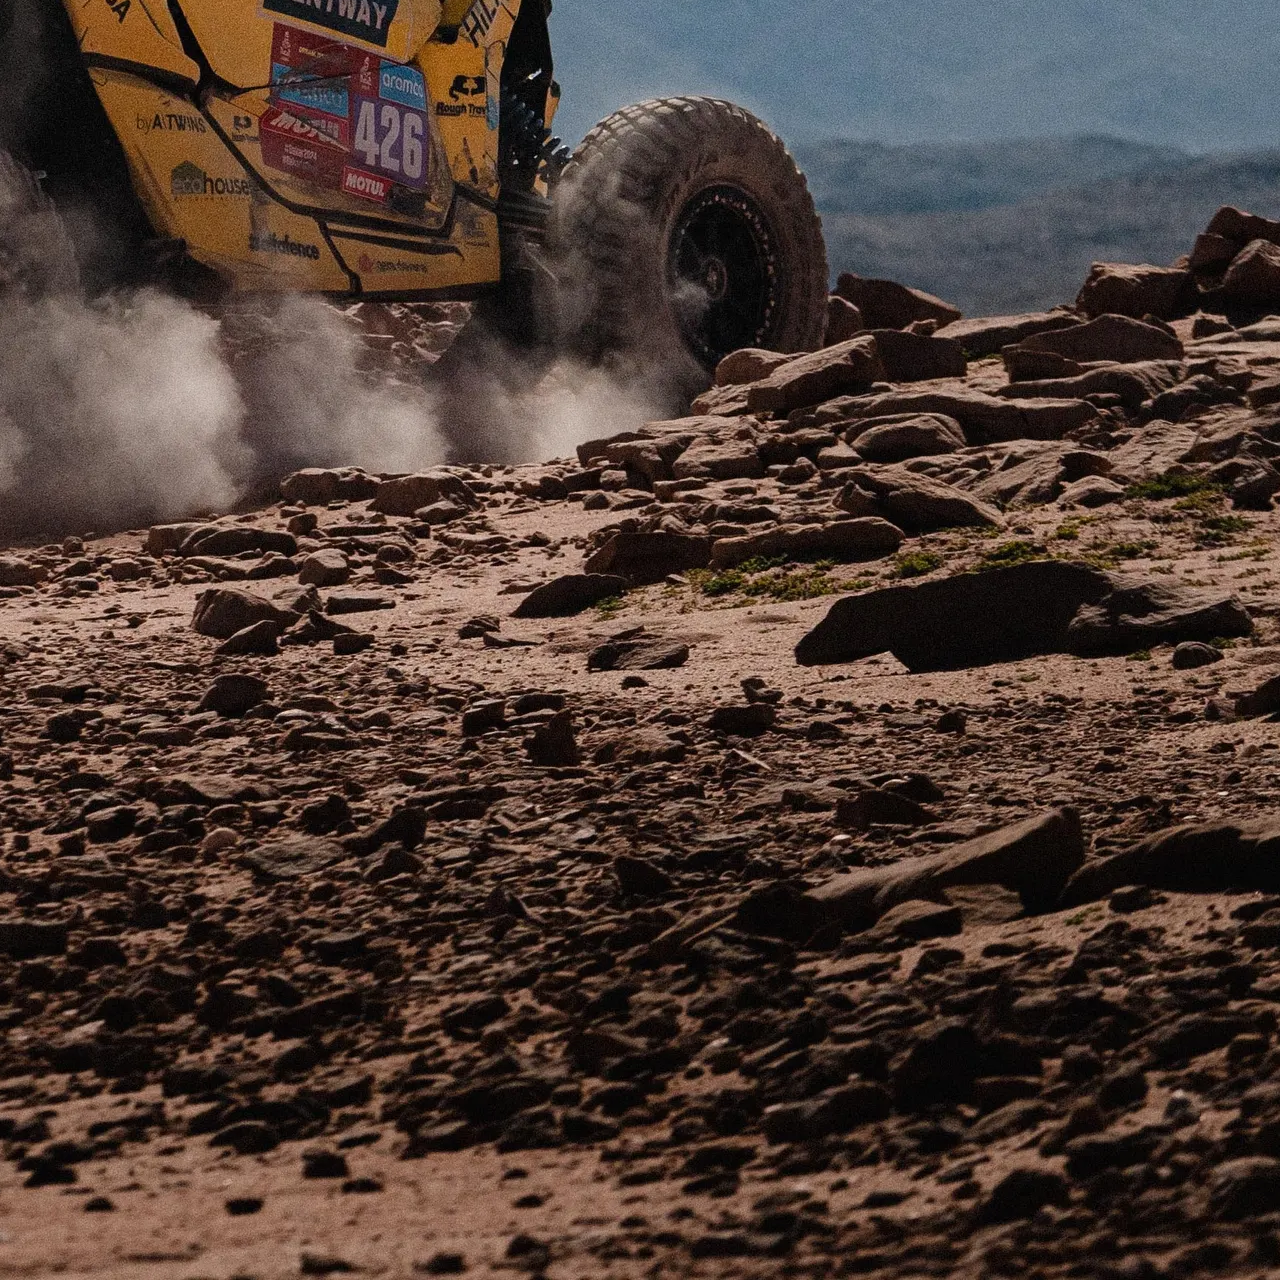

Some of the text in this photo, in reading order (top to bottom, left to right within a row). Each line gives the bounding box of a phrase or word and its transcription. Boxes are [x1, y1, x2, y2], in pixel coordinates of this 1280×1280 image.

[437, 101, 467, 115] Rough
[354, 101, 423, 180] 426
[345, 173, 385, 197] MOTUL
